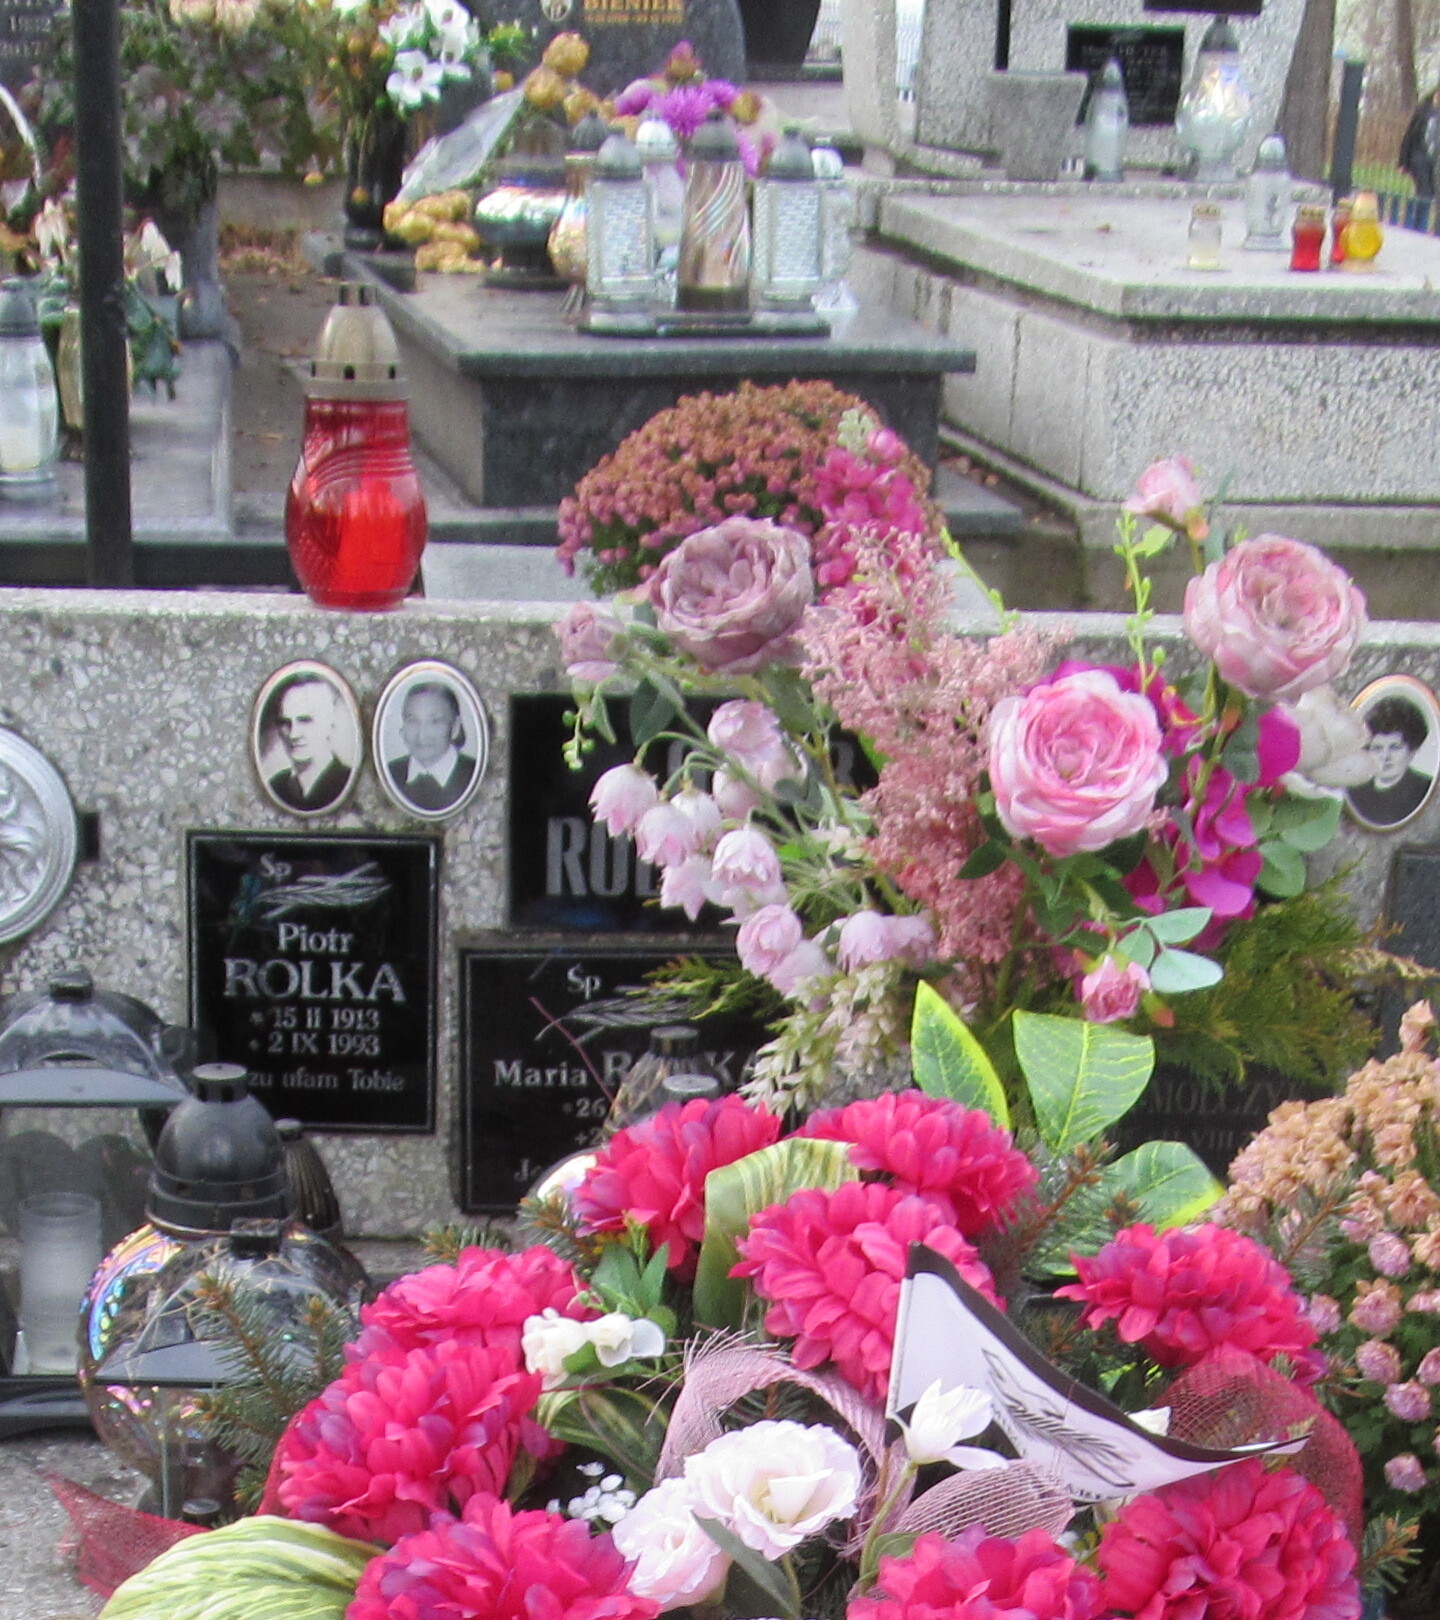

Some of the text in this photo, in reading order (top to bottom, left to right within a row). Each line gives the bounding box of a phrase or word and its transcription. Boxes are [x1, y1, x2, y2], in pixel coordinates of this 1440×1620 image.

[277, 921, 355, 953] Piotr
[222, 956, 407, 1003] ROLKA
[330, 1007, 381, 1032] 1913
[290, 1033, 318, 1056] IX
[328, 1033, 381, 1058] 1993
[281, 1066, 339, 1091] ufam
[348, 1067, 405, 1093] Tobie
[493, 1059, 588, 1087] Maria
